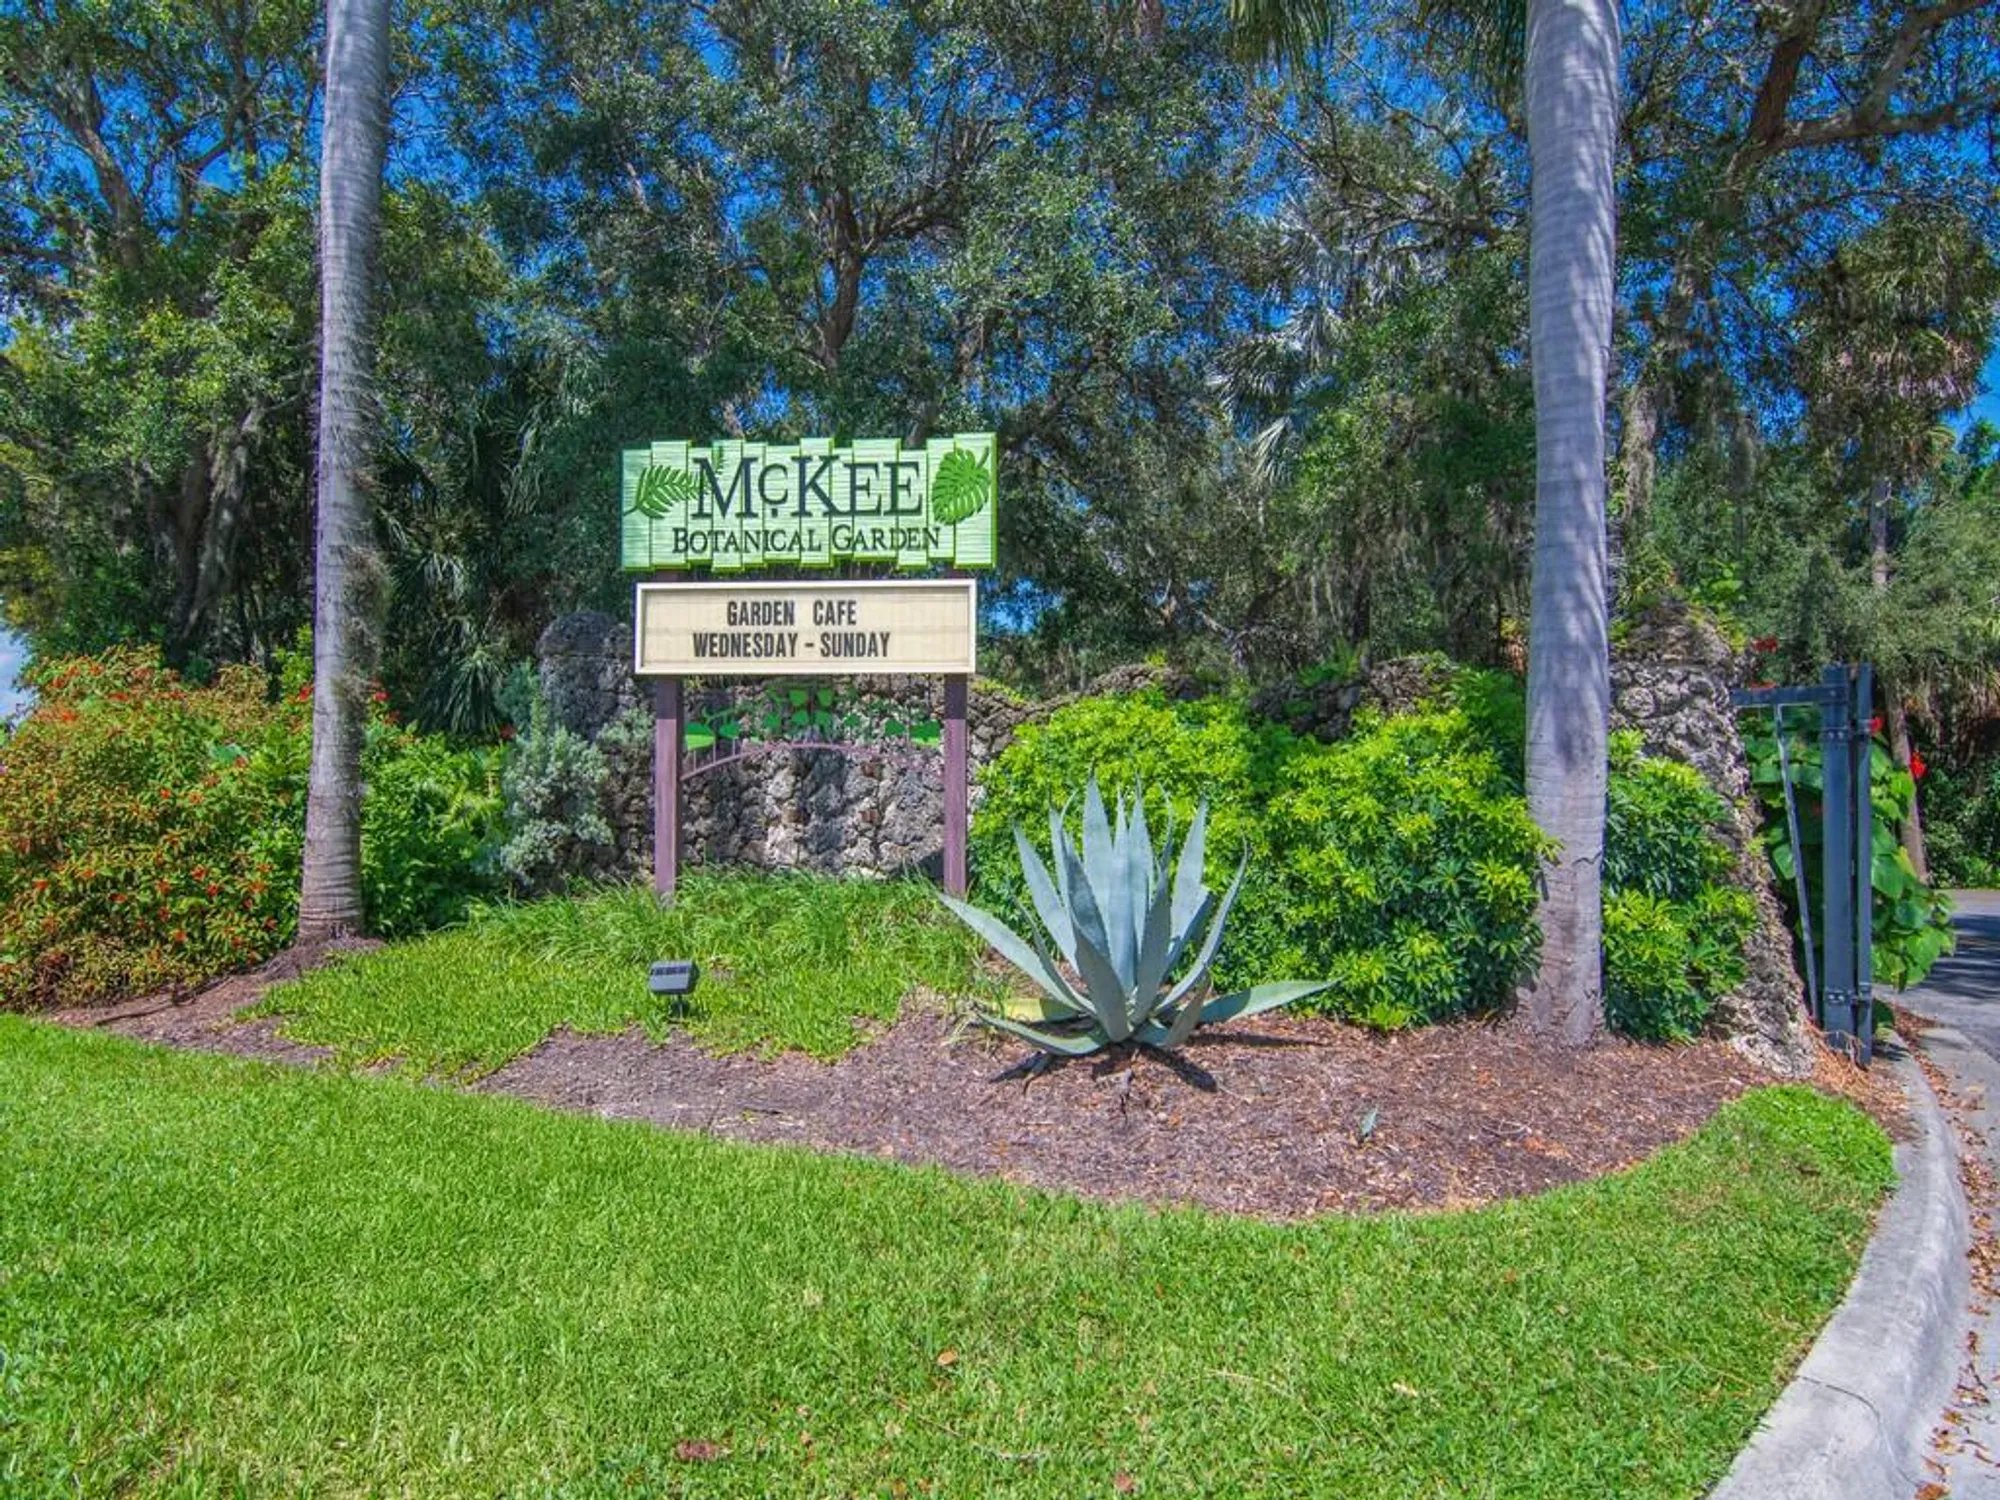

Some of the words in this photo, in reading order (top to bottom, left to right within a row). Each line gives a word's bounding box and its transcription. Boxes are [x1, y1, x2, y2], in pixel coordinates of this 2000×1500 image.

[831, 525, 940, 551] GARDEN
[727, 601, 795, 626] GARDEN
[813, 600, 857, 626] CAFE
[693, 632, 798, 657] WEDNESDAY
[820, 632, 890, 657] SUNDAY
